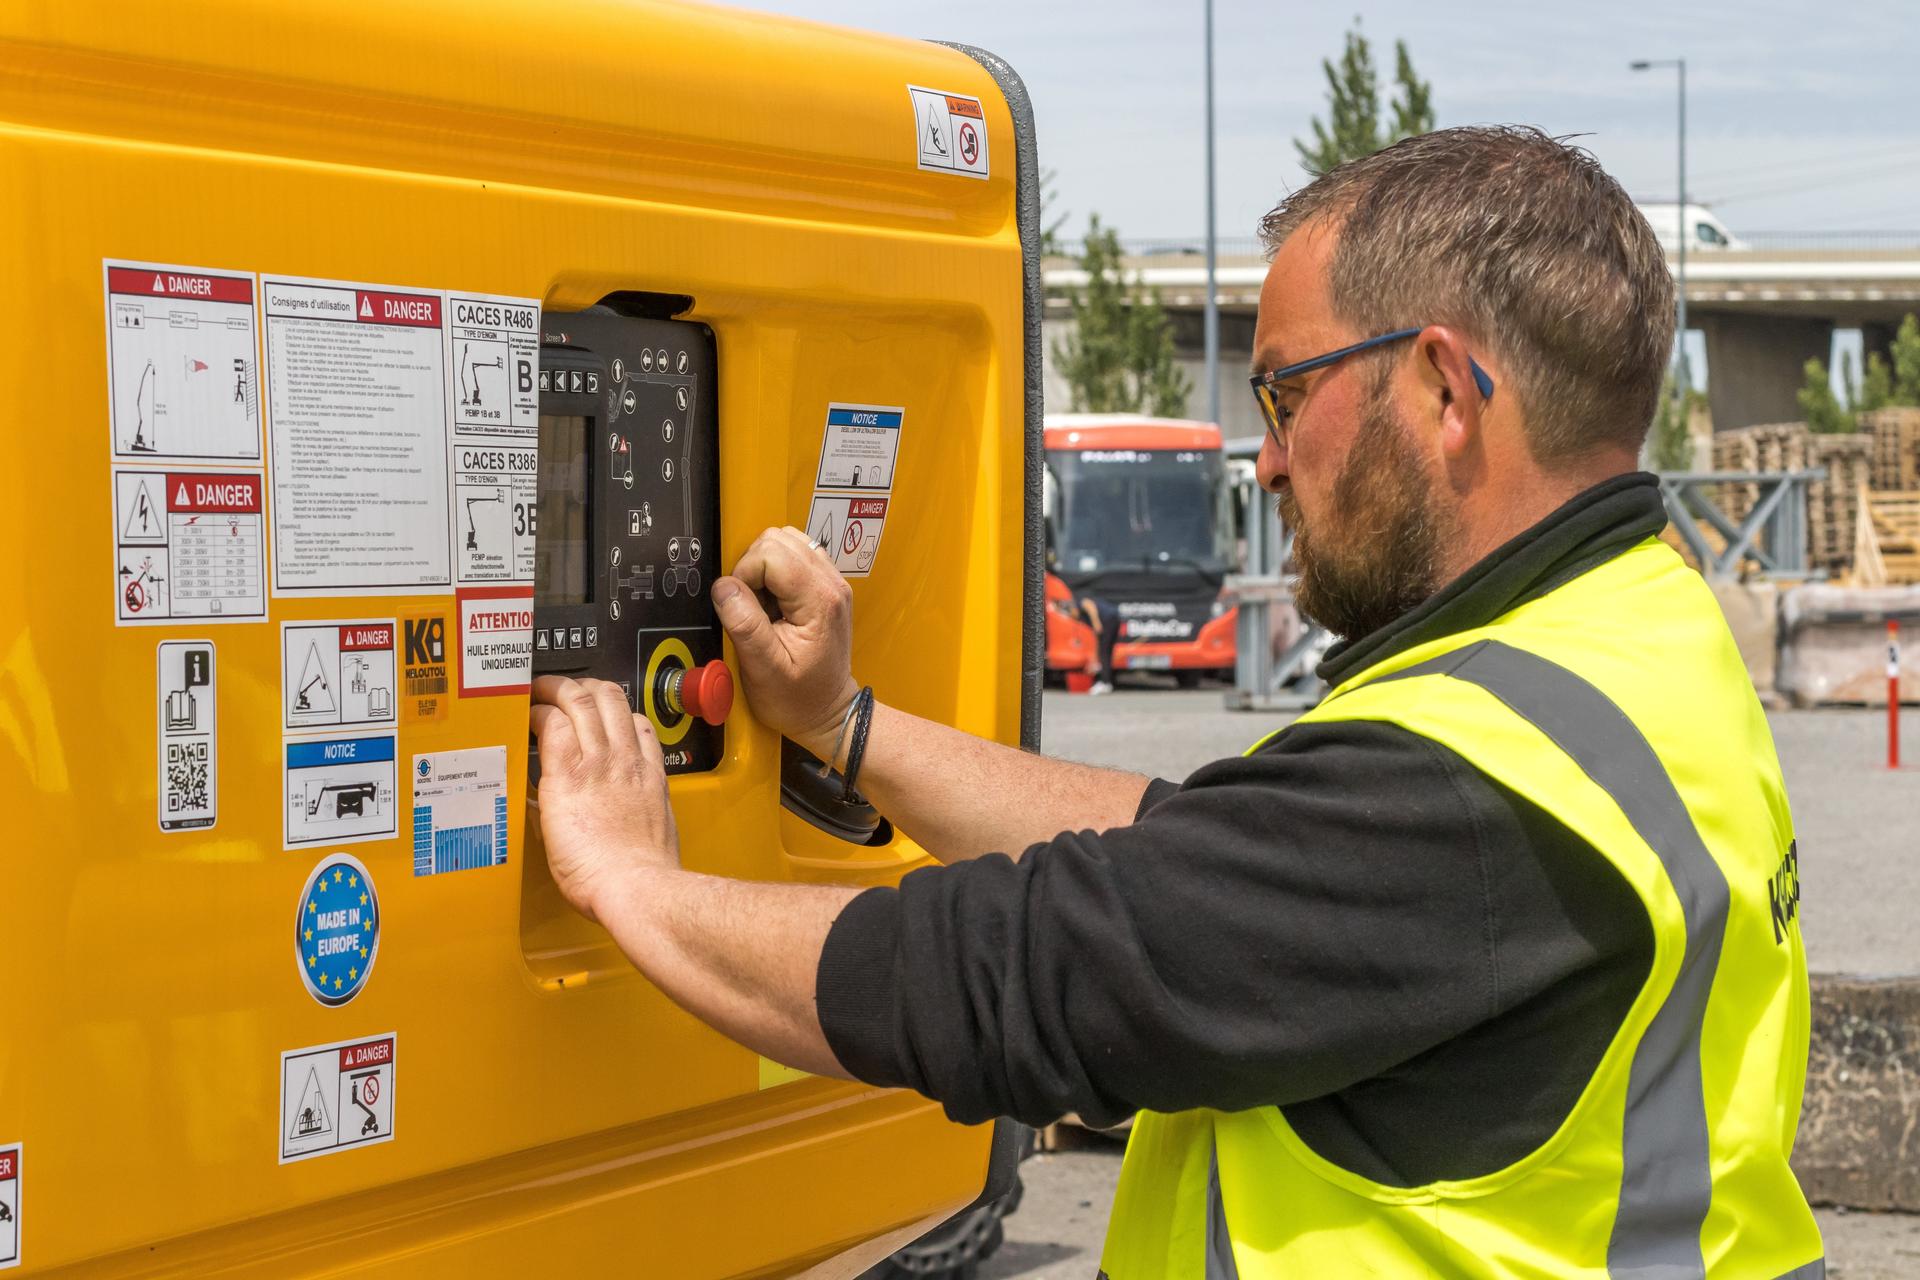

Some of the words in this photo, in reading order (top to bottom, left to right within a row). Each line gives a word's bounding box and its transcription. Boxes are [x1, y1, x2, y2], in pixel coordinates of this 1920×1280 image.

[168, 276, 212, 295] DANGER
[271, 296, 309, 310] Consignes
[311, 299, 350, 312] d'utilisation
[384, 299, 433, 321] DANGER
[458, 304, 500, 326] CACES
[504, 309, 533, 329] R486
[464, 330, 478, 338] TYPE
[479, 330, 498, 340] D'ENGIN
[518, 360, 533, 393] B
[465, 409, 479, 417] PEMP
[852, 414, 878, 425] NOTICE
[463, 452, 505, 470] CACES
[509, 453, 536, 470] R386
[196, 484, 253, 506] DANGER
[861, 503, 884, 514] DANGER
[860, 551, 872, 559] STOP
[357, 630, 389, 645] DANGER
[467, 645, 489, 656] HUILE
[482, 657, 529, 670] UNIQUEMENT
[324, 743, 356, 759] NOTICE
[663, 753, 680, 766] otte
[317, 910, 346, 931] MADE
[349, 908, 360, 925] IN
[318, 934, 359, 957] EUROPE
[356, 1044, 389, 1063] DANGER
